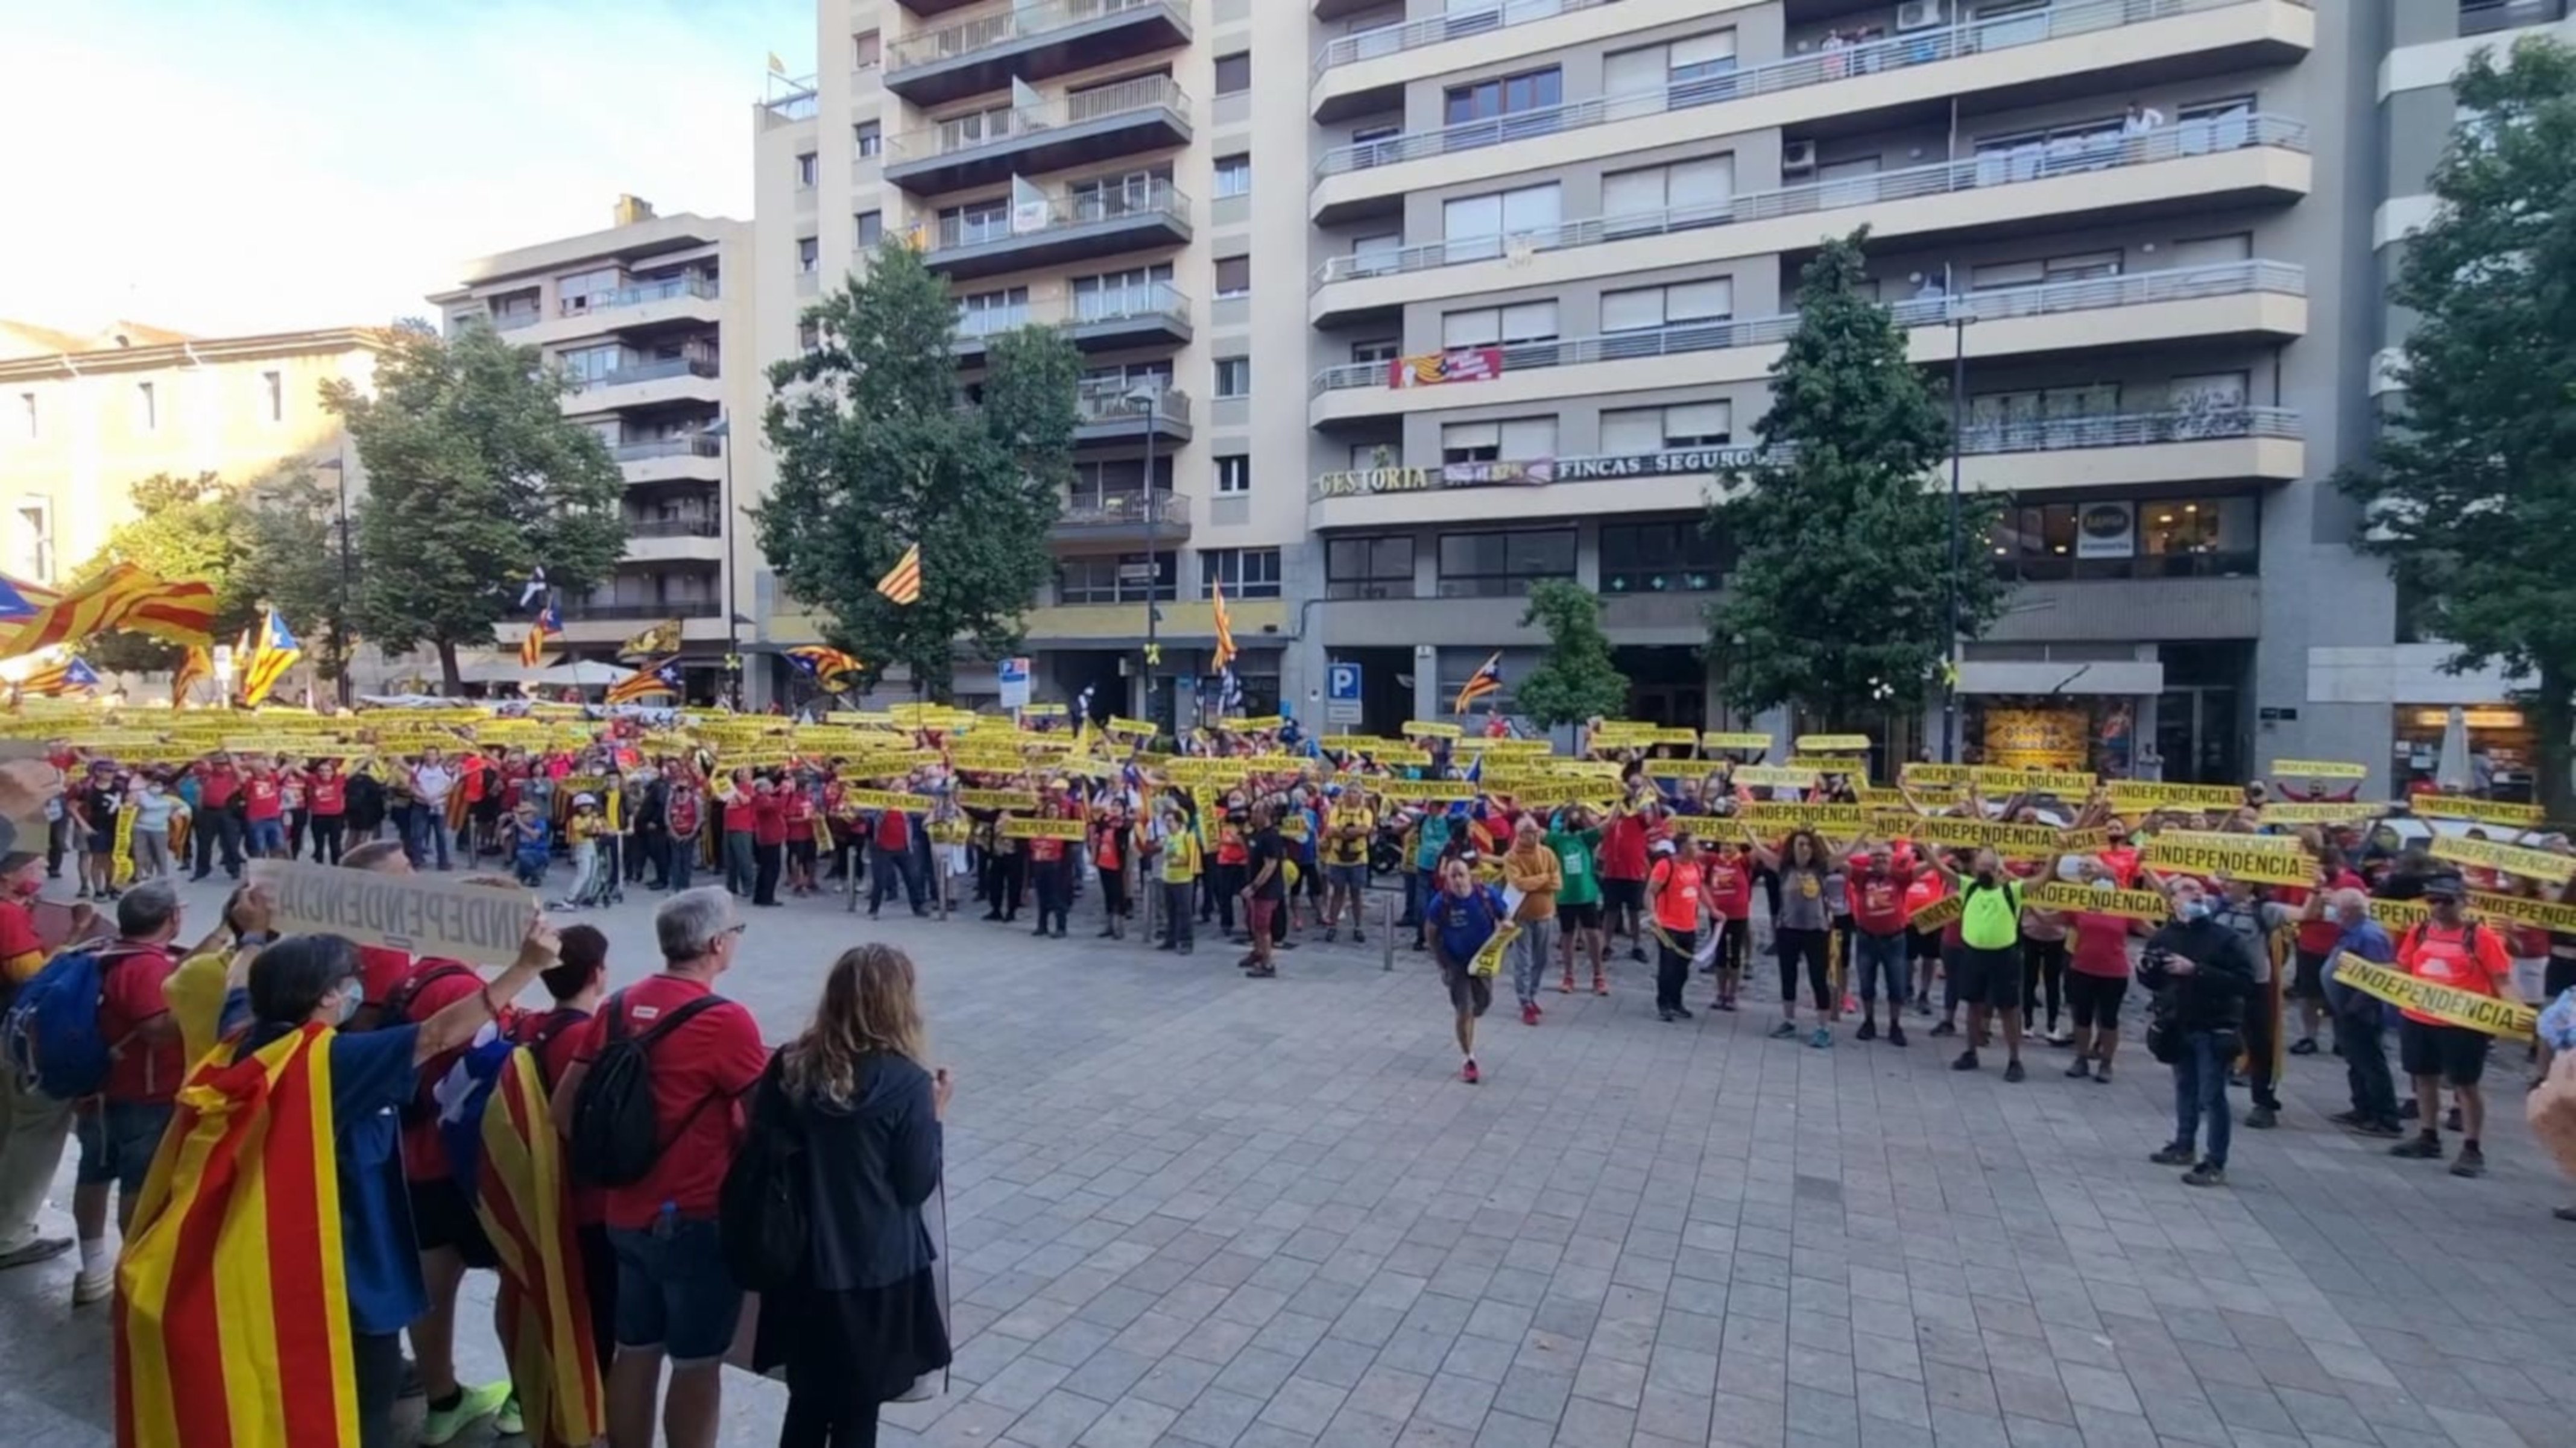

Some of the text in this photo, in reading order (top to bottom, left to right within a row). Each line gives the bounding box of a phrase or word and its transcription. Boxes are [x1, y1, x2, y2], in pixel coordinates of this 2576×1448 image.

[1559, 457, 1640, 478] FINCAS
[1319, 468, 1427, 494] GESTORIA
[1333, 668, 1354, 696] P
